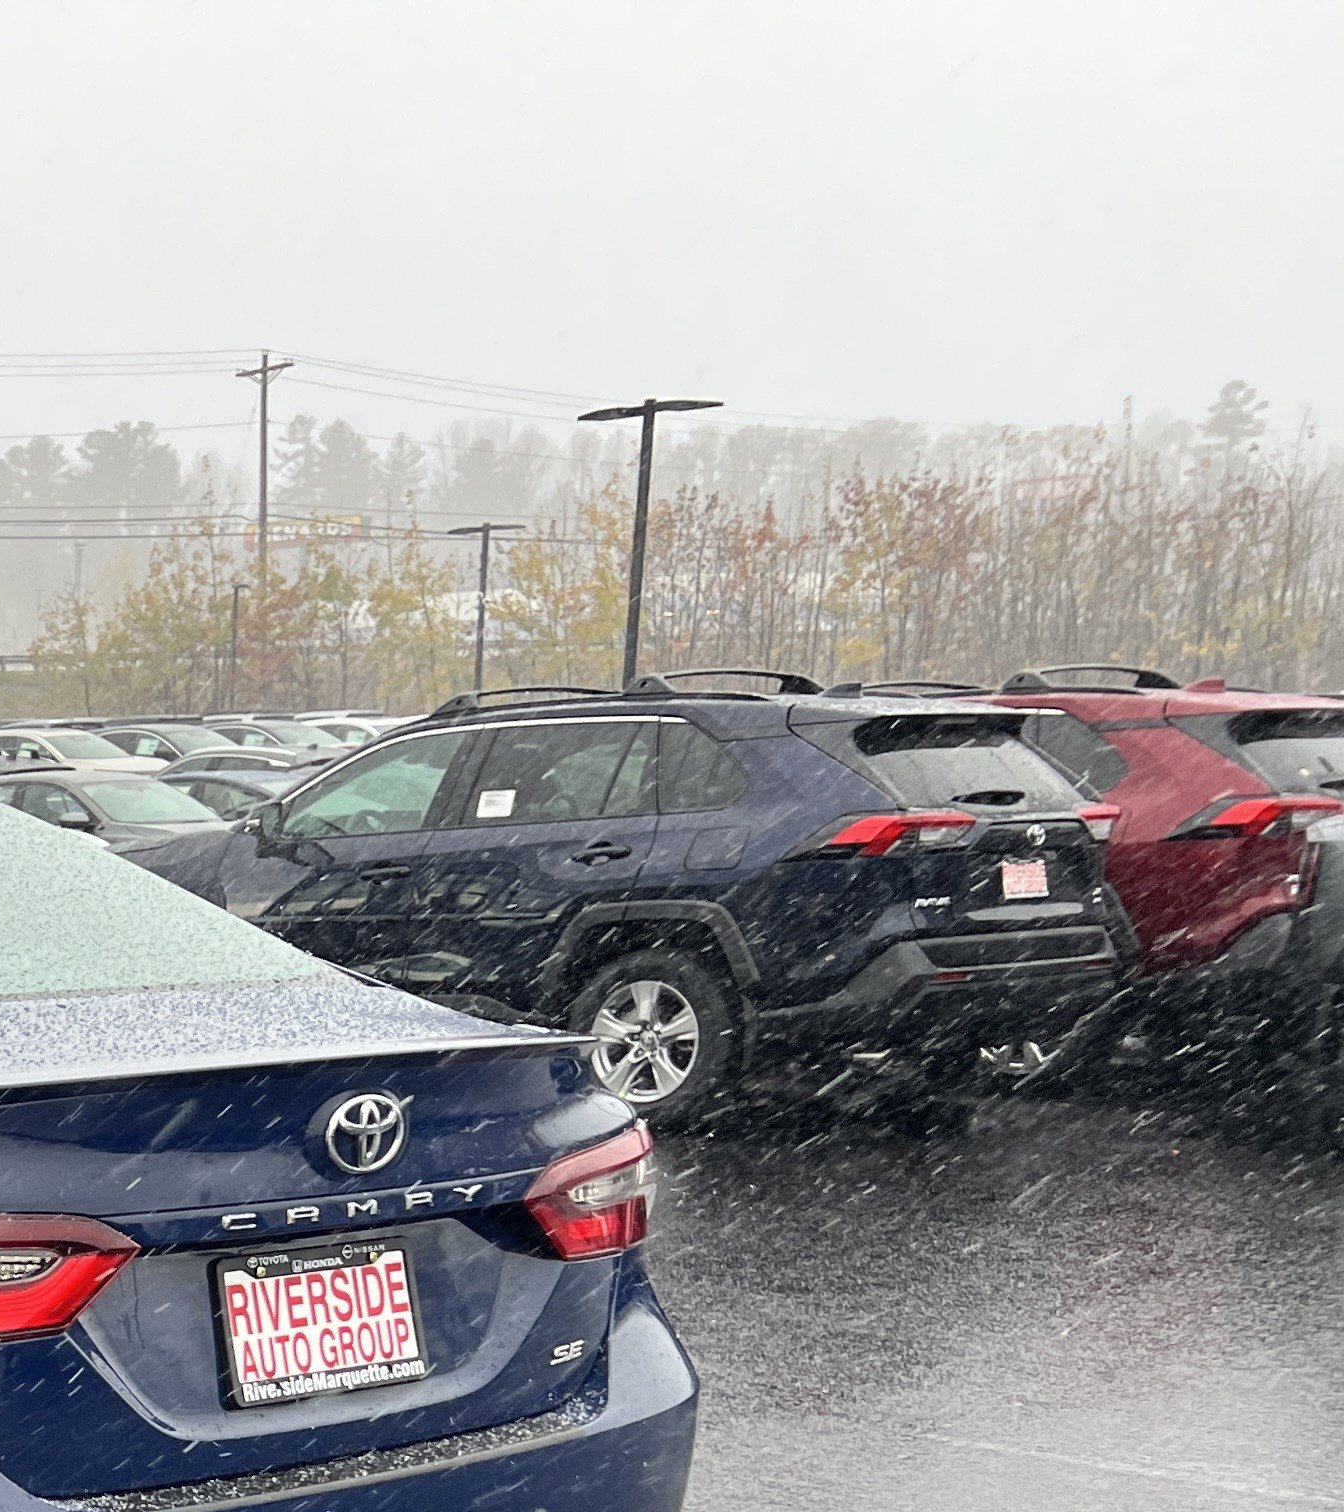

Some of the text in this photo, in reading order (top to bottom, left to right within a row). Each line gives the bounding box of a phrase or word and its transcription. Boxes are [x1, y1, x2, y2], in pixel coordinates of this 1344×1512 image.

[221, 1183, 483, 1231] CAMRY
[258, 1254, 289, 1266] TOYOTA
[303, 1257, 343, 1269] HONDA
[226, 1262, 411, 1337] RIVERSIDE
[243, 1318, 409, 1382] AUTO GROUP
[550, 1340, 585, 1366] SE
